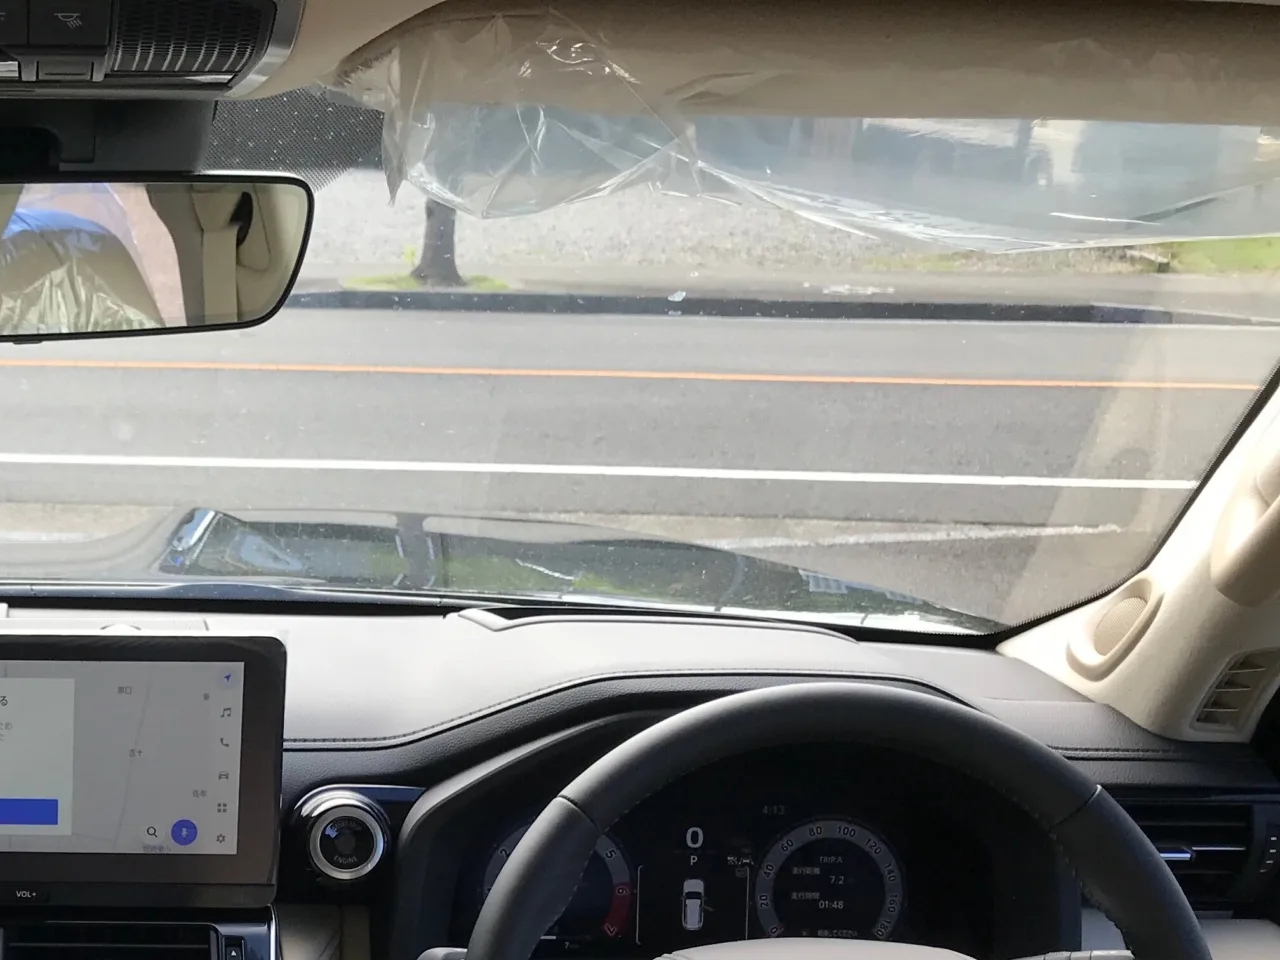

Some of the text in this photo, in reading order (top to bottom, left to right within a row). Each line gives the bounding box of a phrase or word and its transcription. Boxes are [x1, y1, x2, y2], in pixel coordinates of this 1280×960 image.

[686, 826, 704, 848] 0
[808, 826, 823, 837] 80
[836, 826, 857, 838] 100
[780, 838, 795, 852] 60
[864, 838, 883, 855] 120
[604, 848, 617, 860] 5
[690, 856, 699, 866] P
[762, 864, 775, 879] 40
[884, 863, 897, 882] 140
[829, 876, 845, 885] 7.2
[758, 894, 771, 908] 20
[818, 900, 844, 909] 01:48
[887, 893, 898, 913] 160
[875, 919, 891, 938] 180
